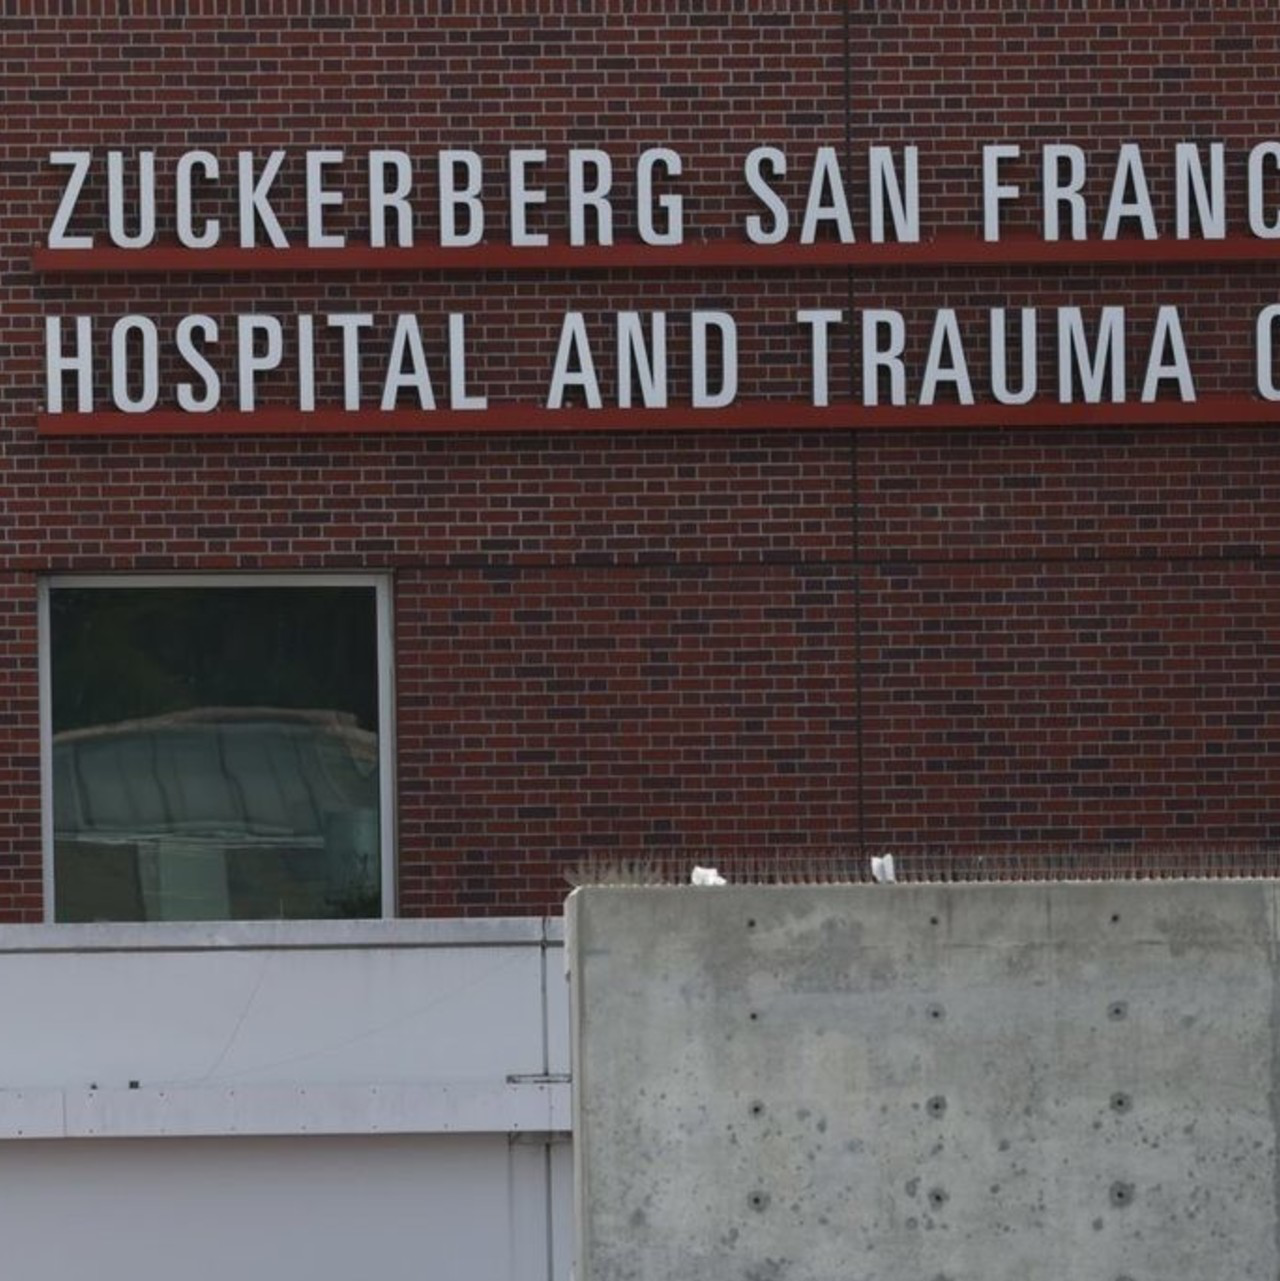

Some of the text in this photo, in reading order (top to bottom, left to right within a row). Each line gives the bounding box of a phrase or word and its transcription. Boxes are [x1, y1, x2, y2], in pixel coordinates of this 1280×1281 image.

[47, 146, 683, 250] ZUCKERBERG
[744, 145, 920, 245] SAN
[45, 312, 488, 414] HOSPITAL
[546, 310, 738, 410] AND
[797, 305, 1196, 407] TRAUMA
